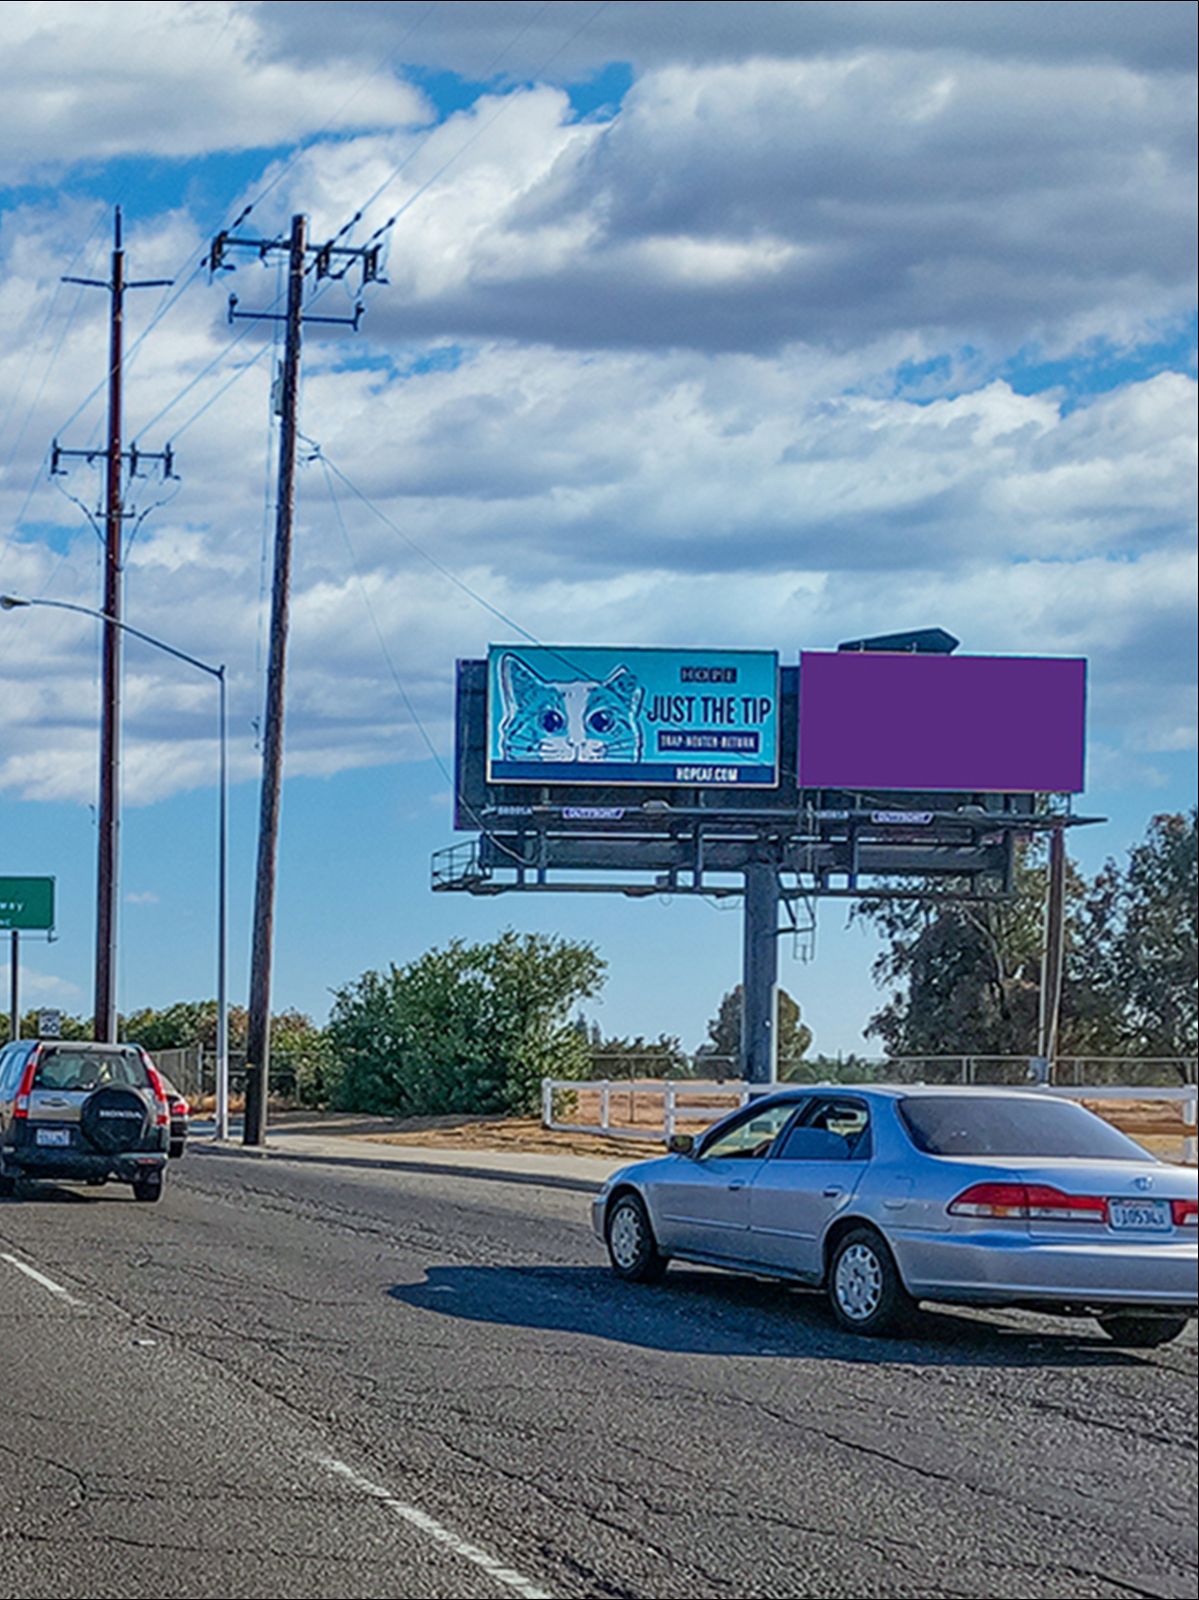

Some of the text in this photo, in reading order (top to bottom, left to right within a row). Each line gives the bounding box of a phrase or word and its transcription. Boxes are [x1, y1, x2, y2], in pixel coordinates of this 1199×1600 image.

[647, 695, 771, 725] JUST THE TIP
[41, 1022, 59, 1034] 40
[100, 1109, 142, 1119] HONDA
